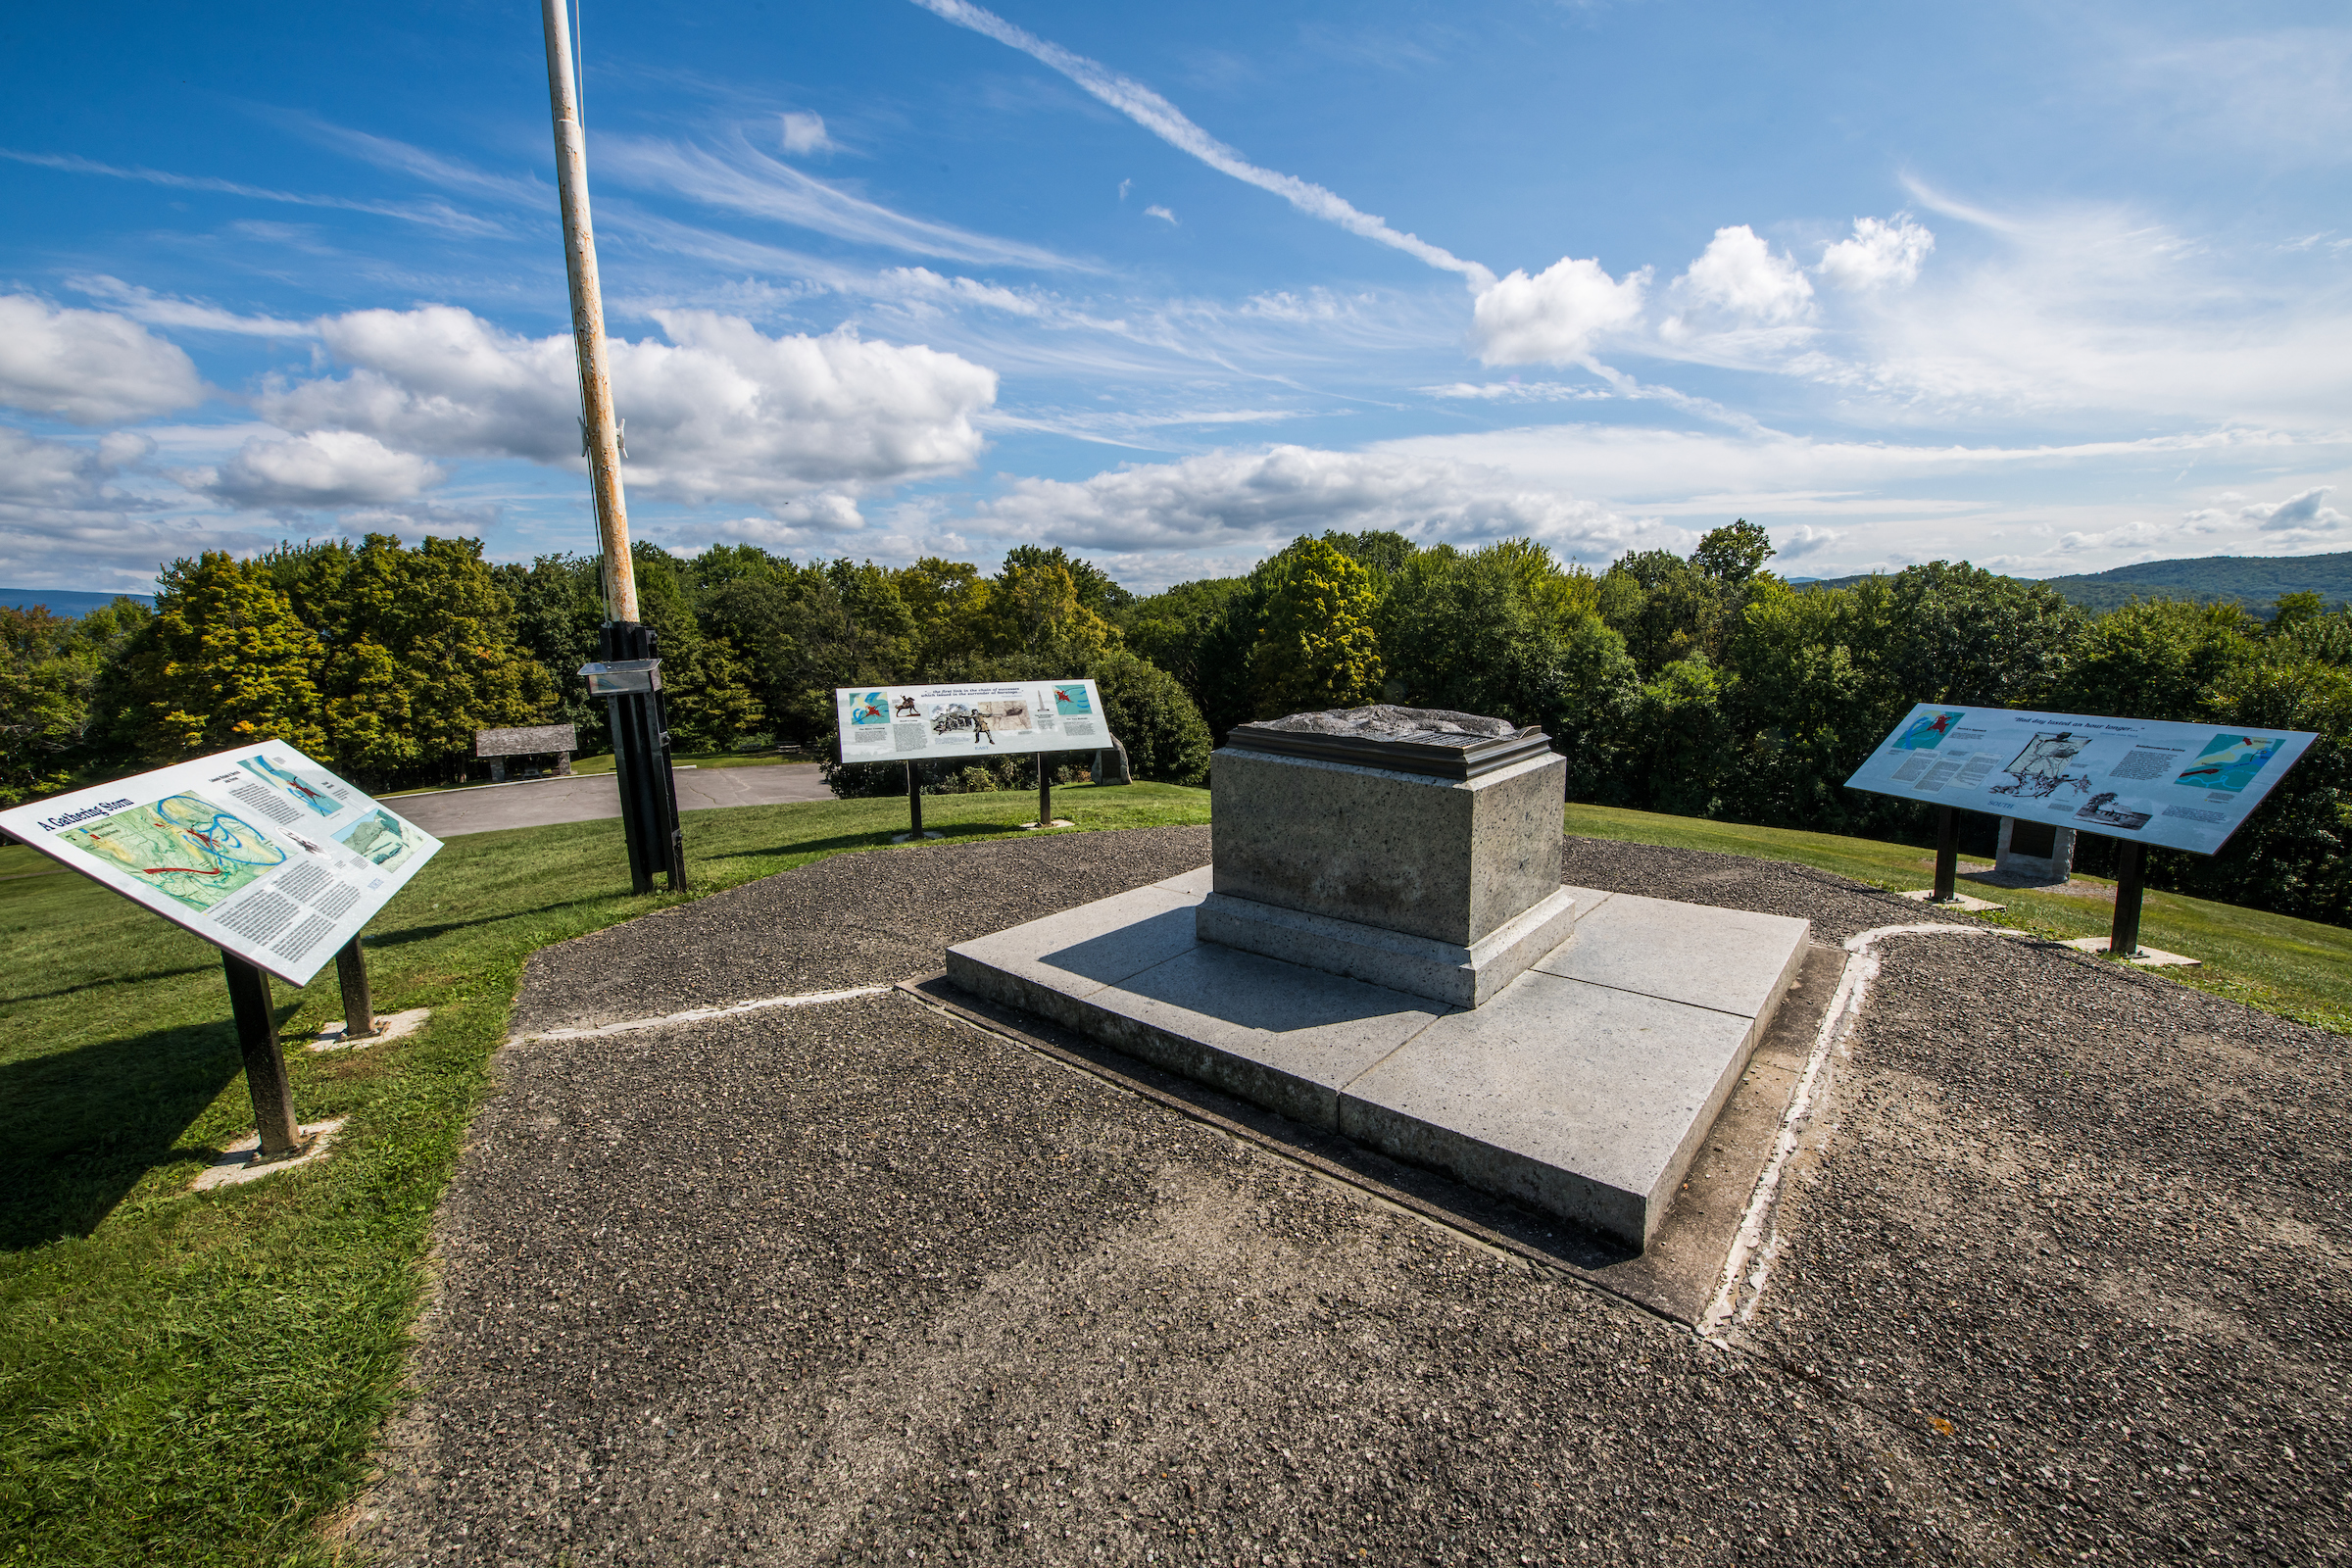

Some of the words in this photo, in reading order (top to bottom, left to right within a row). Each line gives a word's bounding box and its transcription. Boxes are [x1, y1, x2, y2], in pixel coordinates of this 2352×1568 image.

[1987, 800, 2015, 808] SOUTH
[37, 821, 56, 831] A
[47, 808, 110, 827] Gathering
[98, 798, 134, 811] Storm
